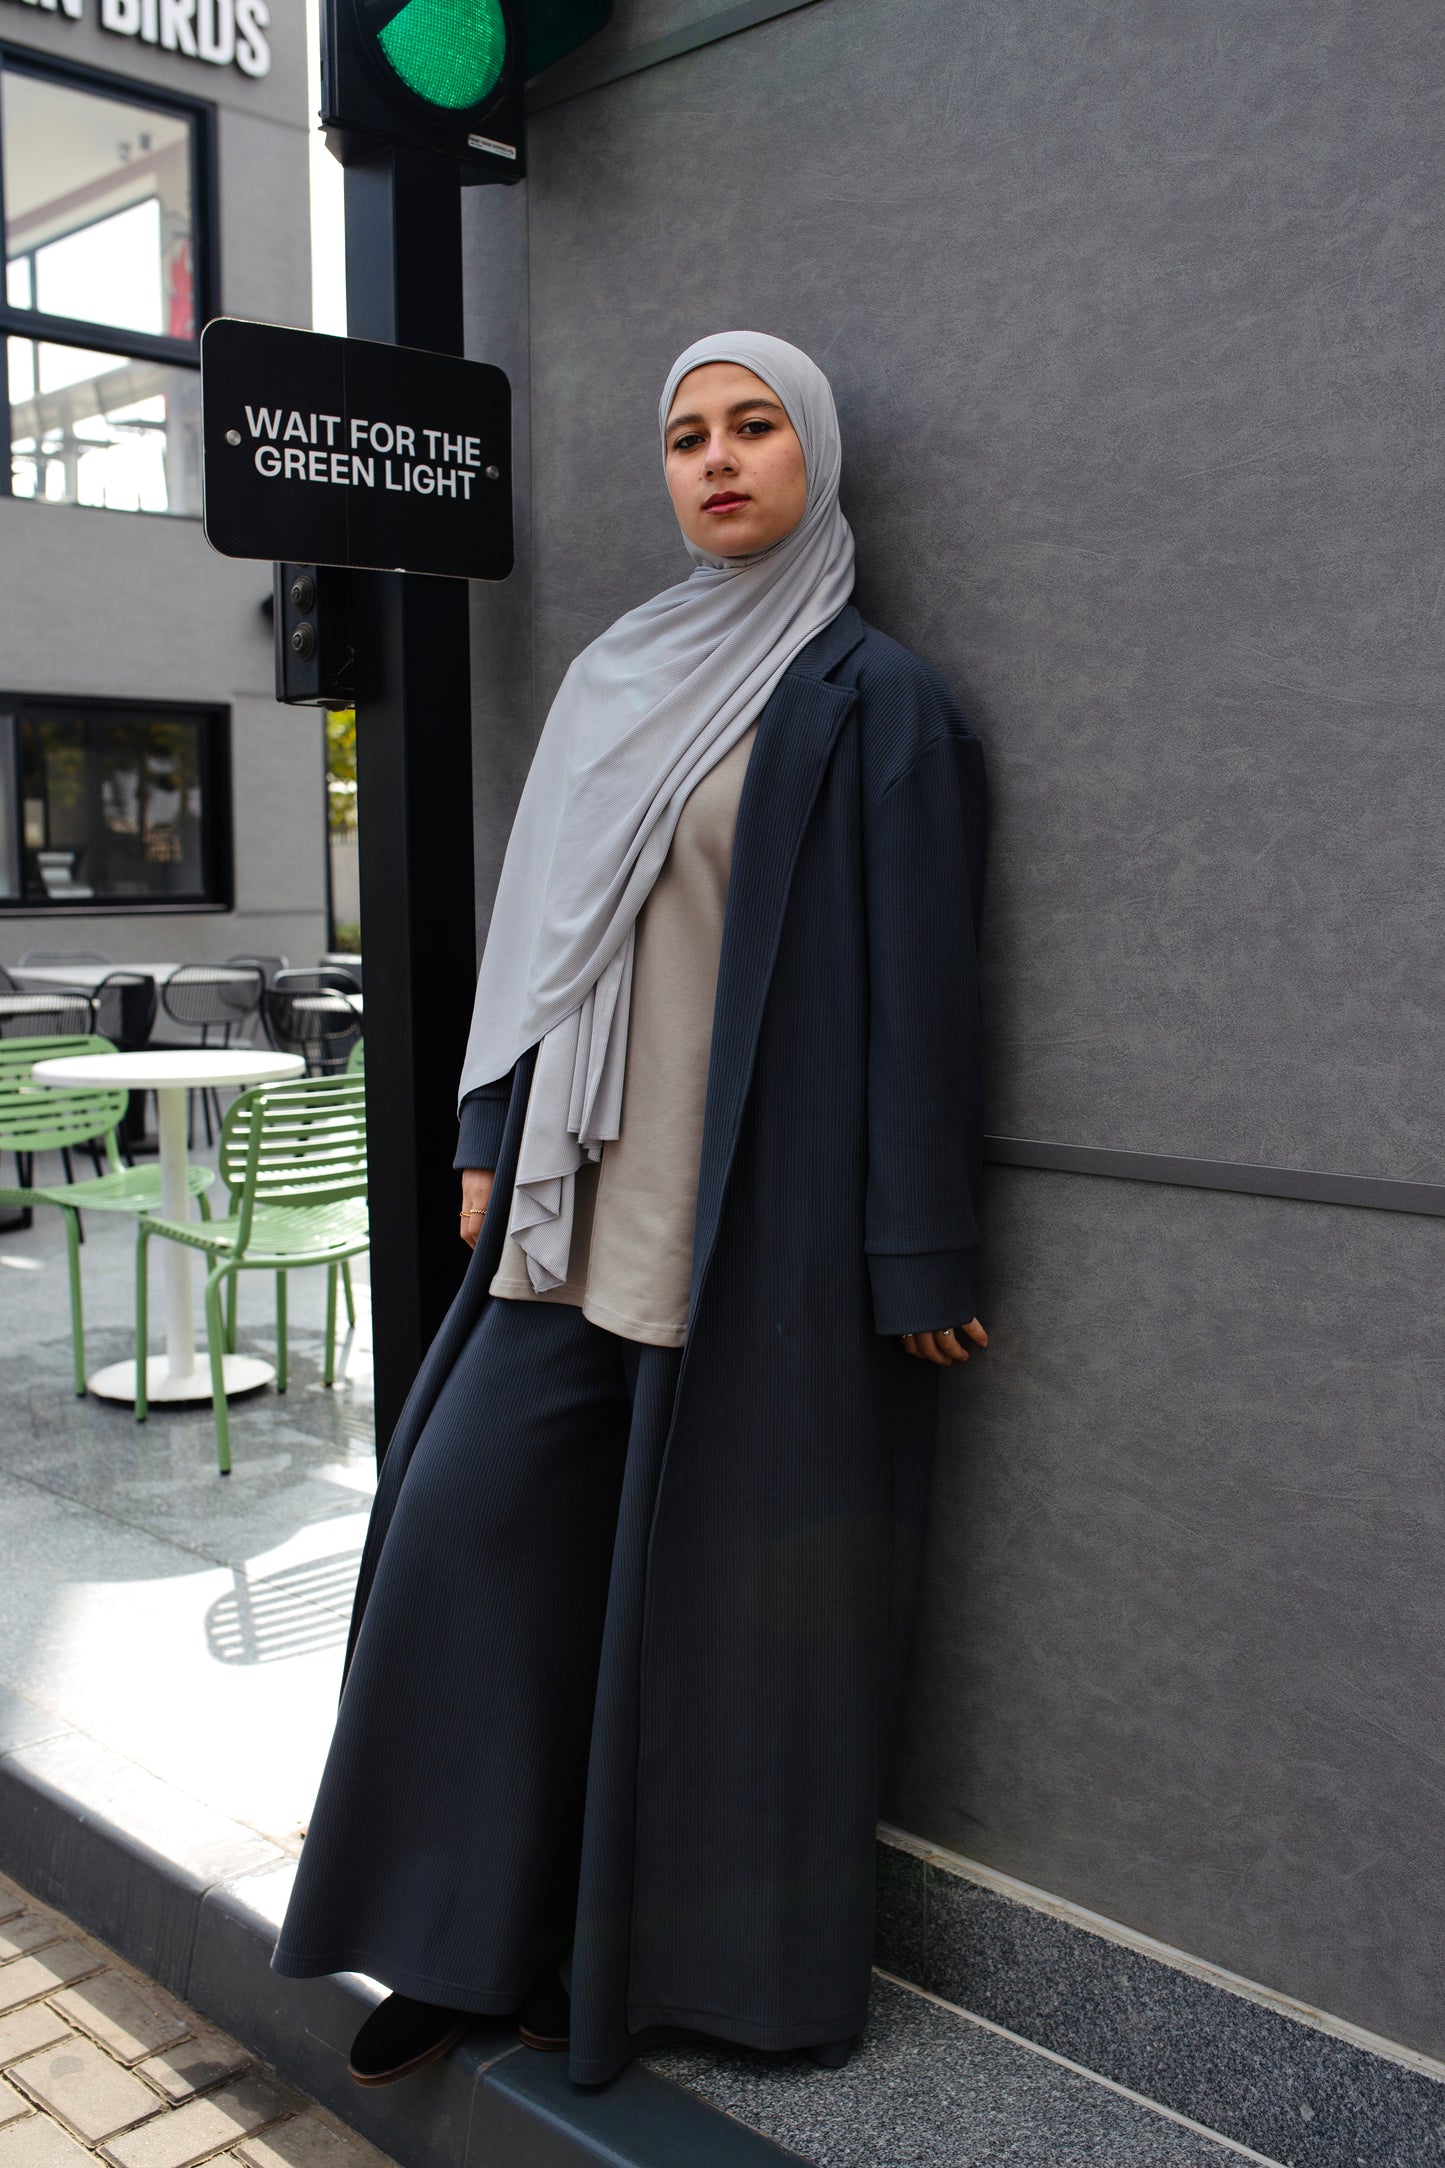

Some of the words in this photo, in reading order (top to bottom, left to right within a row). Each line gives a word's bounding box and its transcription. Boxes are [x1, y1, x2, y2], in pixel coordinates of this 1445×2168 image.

[244, 405, 341, 446] WAIT
[350, 418, 416, 457] FOR
[422, 429, 481, 467] THE
[254, 445, 375, 488] GREEN
[385, 459, 476, 500] LIGHT
